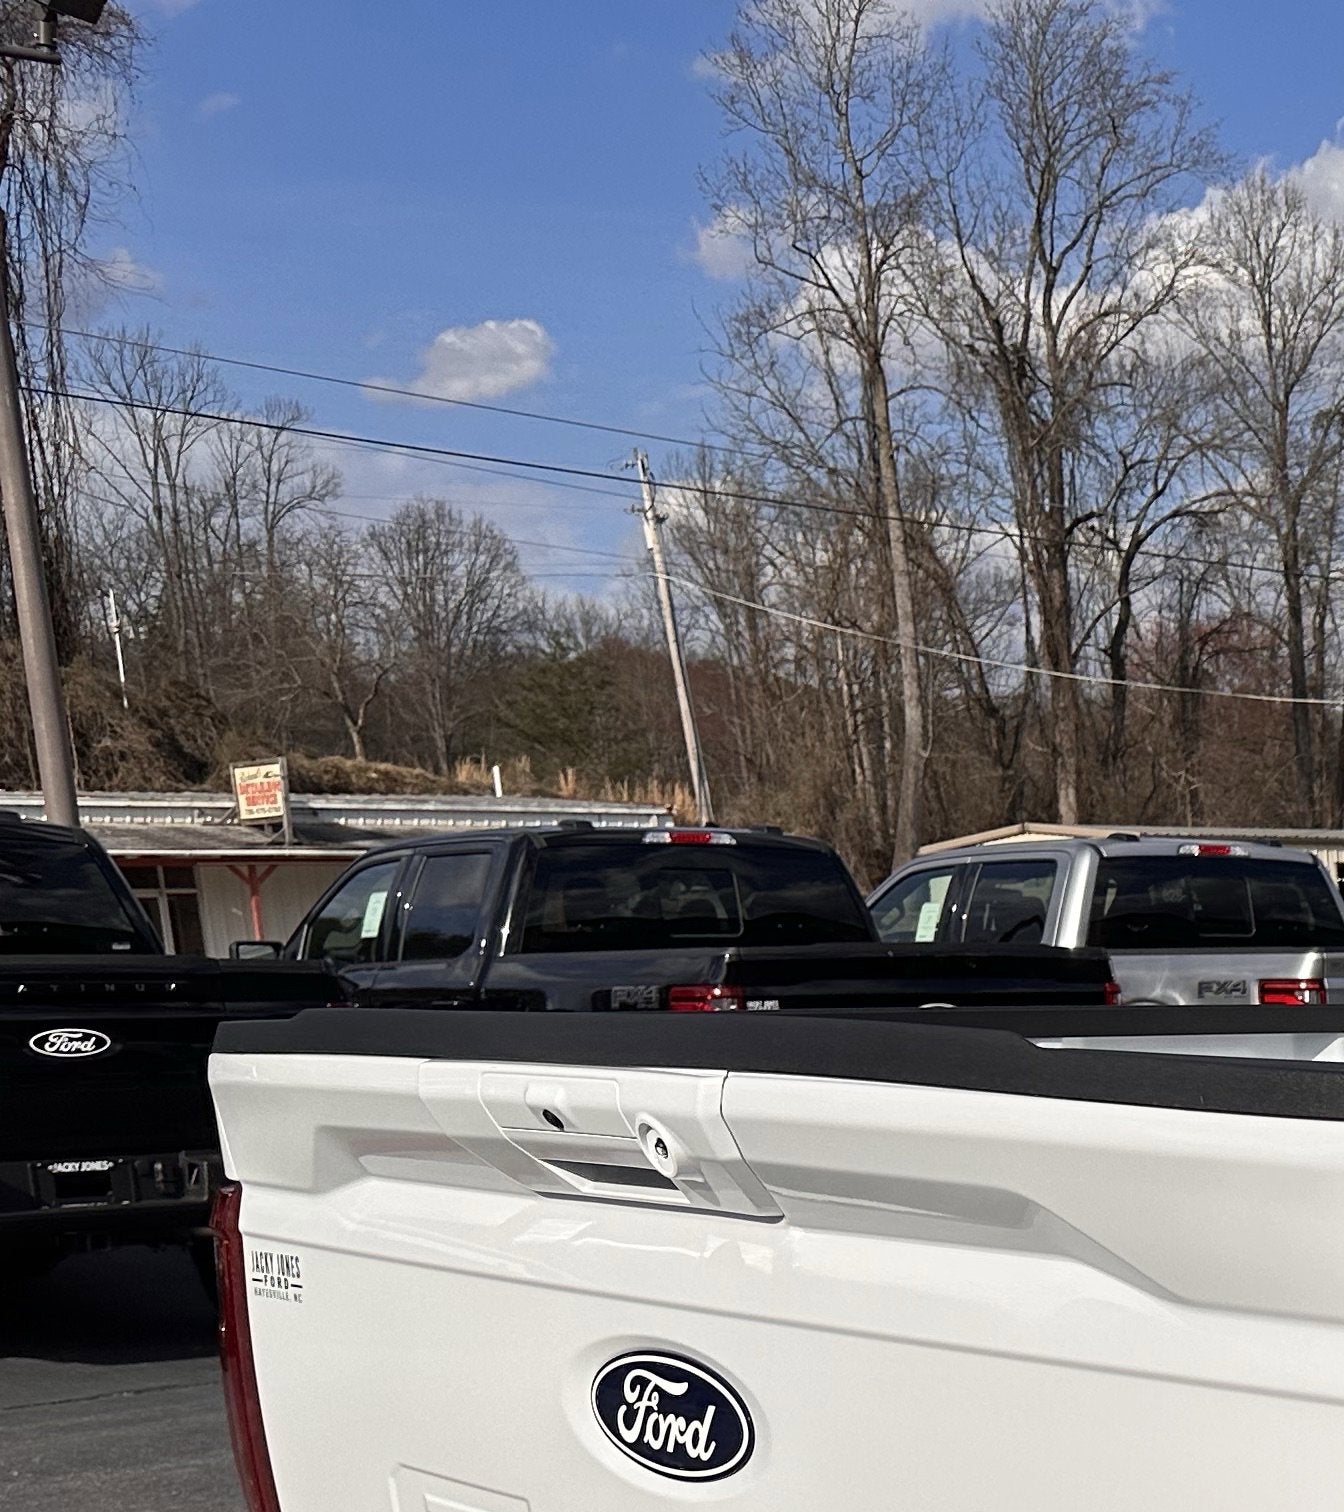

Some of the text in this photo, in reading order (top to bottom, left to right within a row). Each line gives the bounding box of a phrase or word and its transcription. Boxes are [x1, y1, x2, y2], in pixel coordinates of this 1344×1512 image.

[1198, 979, 1247, 999] FX4
[251, 1250, 301, 1279] JACKY JONES
[263, 1274, 289, 1290] FORD
[616, 1368, 717, 1462] Ford
